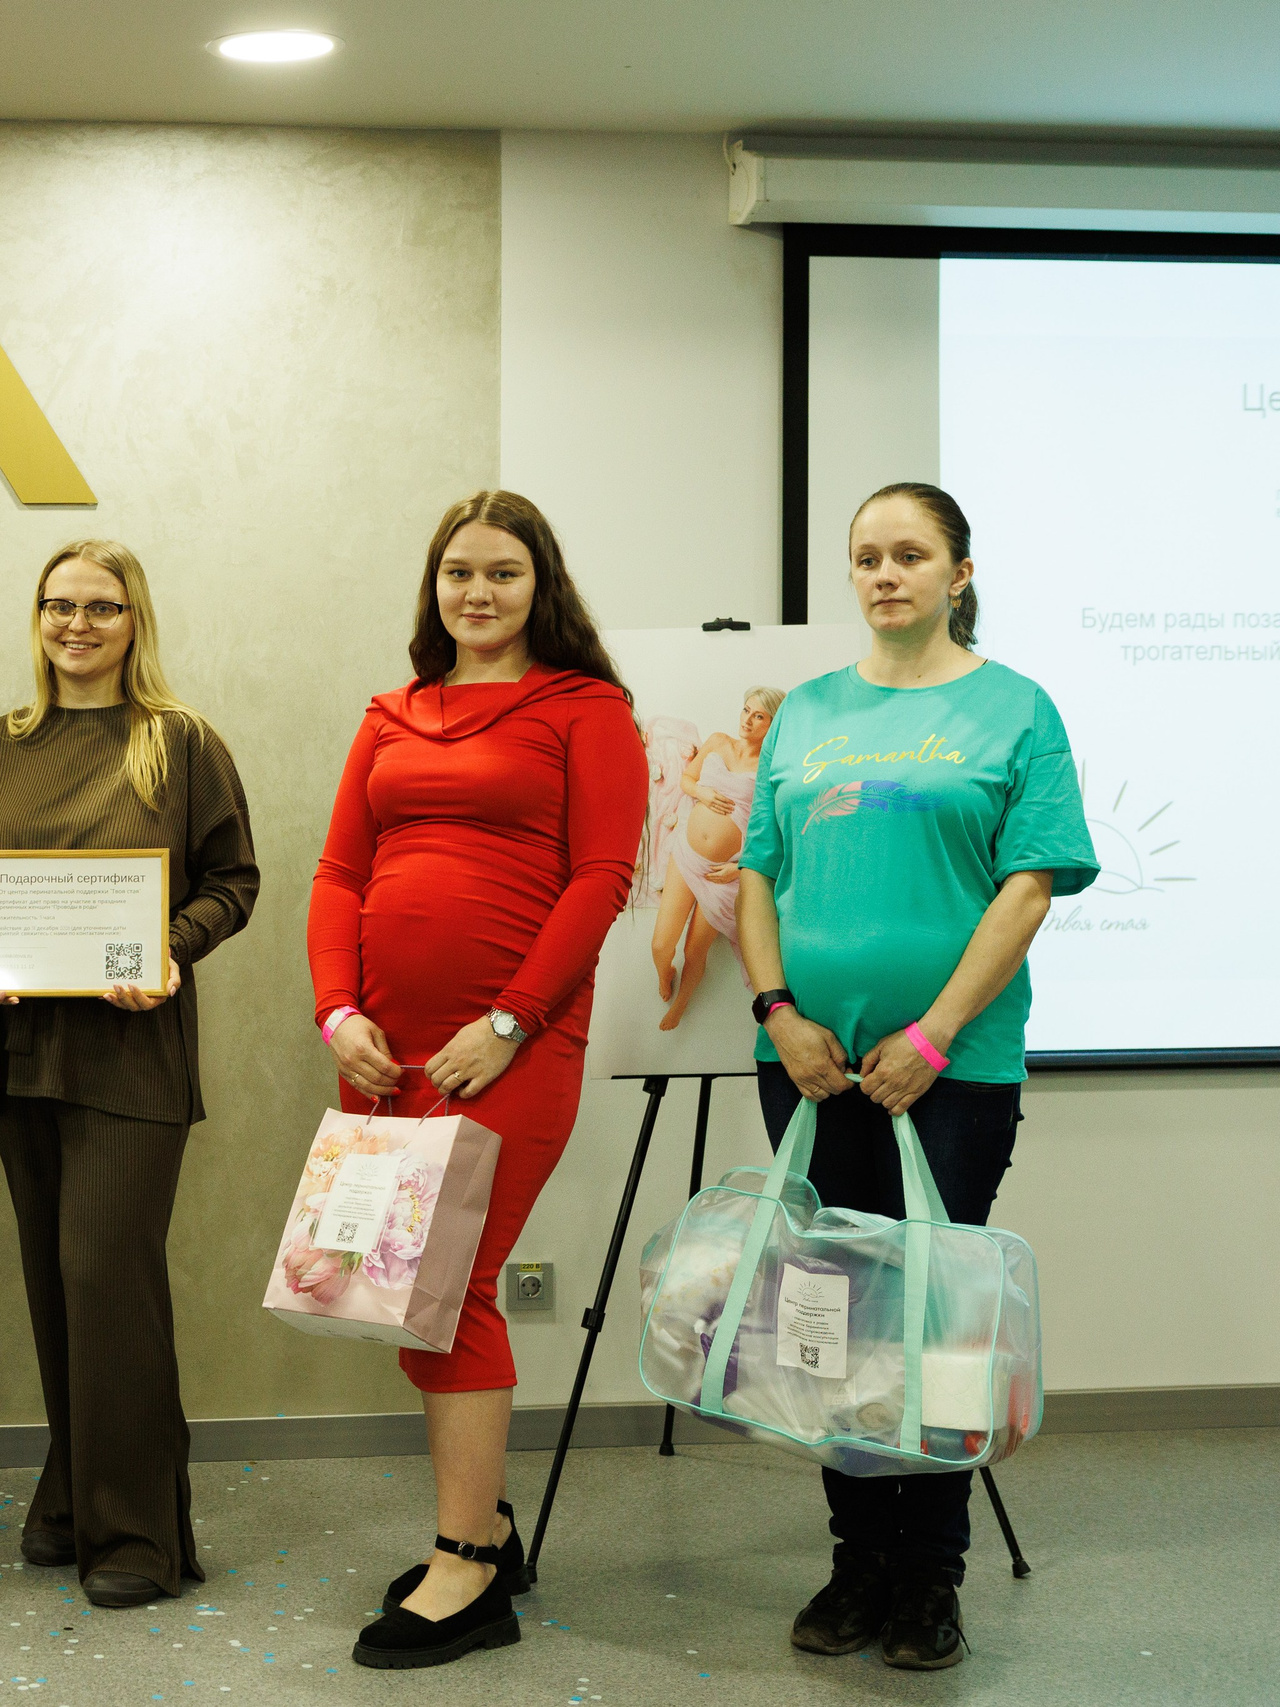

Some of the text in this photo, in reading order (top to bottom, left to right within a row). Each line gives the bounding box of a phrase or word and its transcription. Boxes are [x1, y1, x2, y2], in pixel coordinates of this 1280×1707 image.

[1243, 384, 1280, 418] Це
[1081, 607, 1280, 634] Будем рады поза
[1121, 641, 1280, 666] трогательный
[803, 734, 966, 784] Samantha
[0, 873, 146, 885] Подарочный сертификат
[1100, 917, 1150, 931] стая
